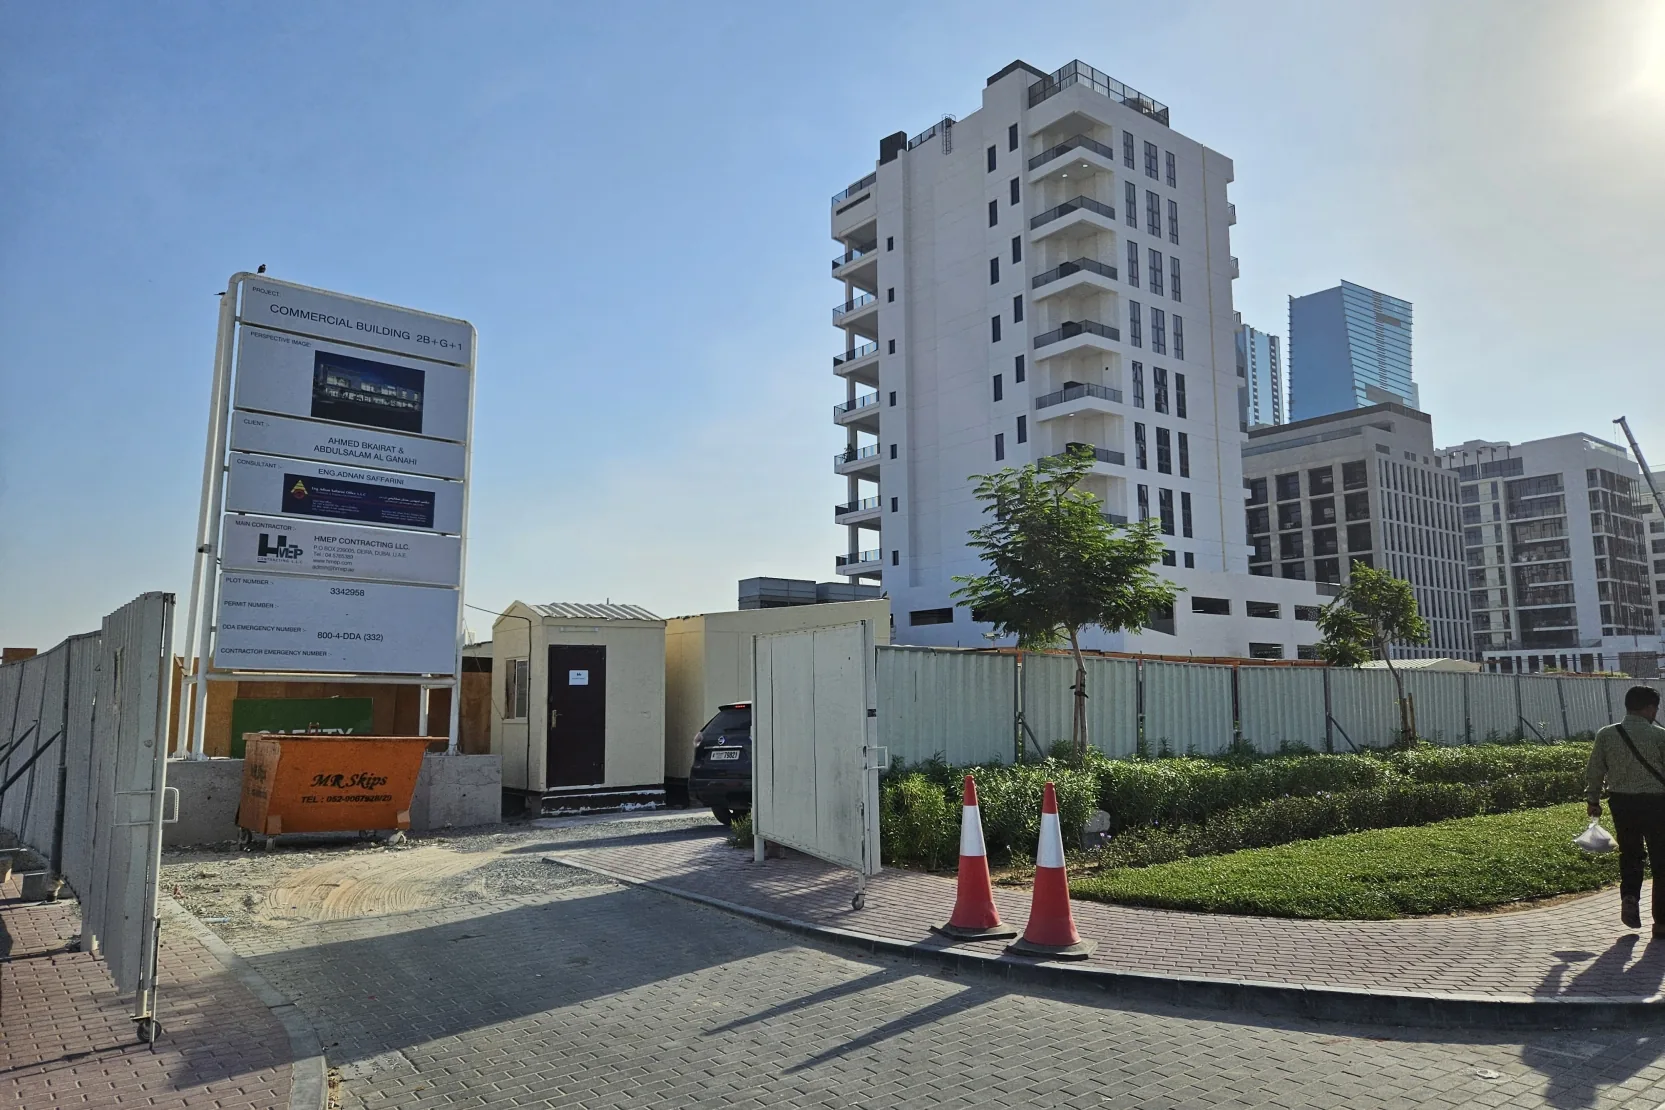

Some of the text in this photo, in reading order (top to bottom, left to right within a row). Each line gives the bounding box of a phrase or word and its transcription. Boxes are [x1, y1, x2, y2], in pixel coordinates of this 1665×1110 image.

[270, 304, 462, 351] COMMERCIAL BUILDING 2B+G+1
[251, 331, 290, 344] PERSPECTIVE
[243, 418, 264, 427] CLIENT
[328, 437, 360, 448] AHMED
[361, 441, 397, 454] BKAIRAT
[313, 445, 417, 465] ABDULSALAM AL GANAHI
[236, 458, 277, 469] CONSULTANT
[366, 474, 404, 485] SAFFARINI
[251, 522, 292, 531] CONTRACTOR
[313, 535, 337, 543] HMEP
[338, 537, 394, 549] CONTRACTING
[330, 587, 365, 597] 3342958
[317, 631, 384, 642] 800-4-DDA (332)
[310, 772, 388, 790] MR Skips
[301, 796, 318, 804] TEL
